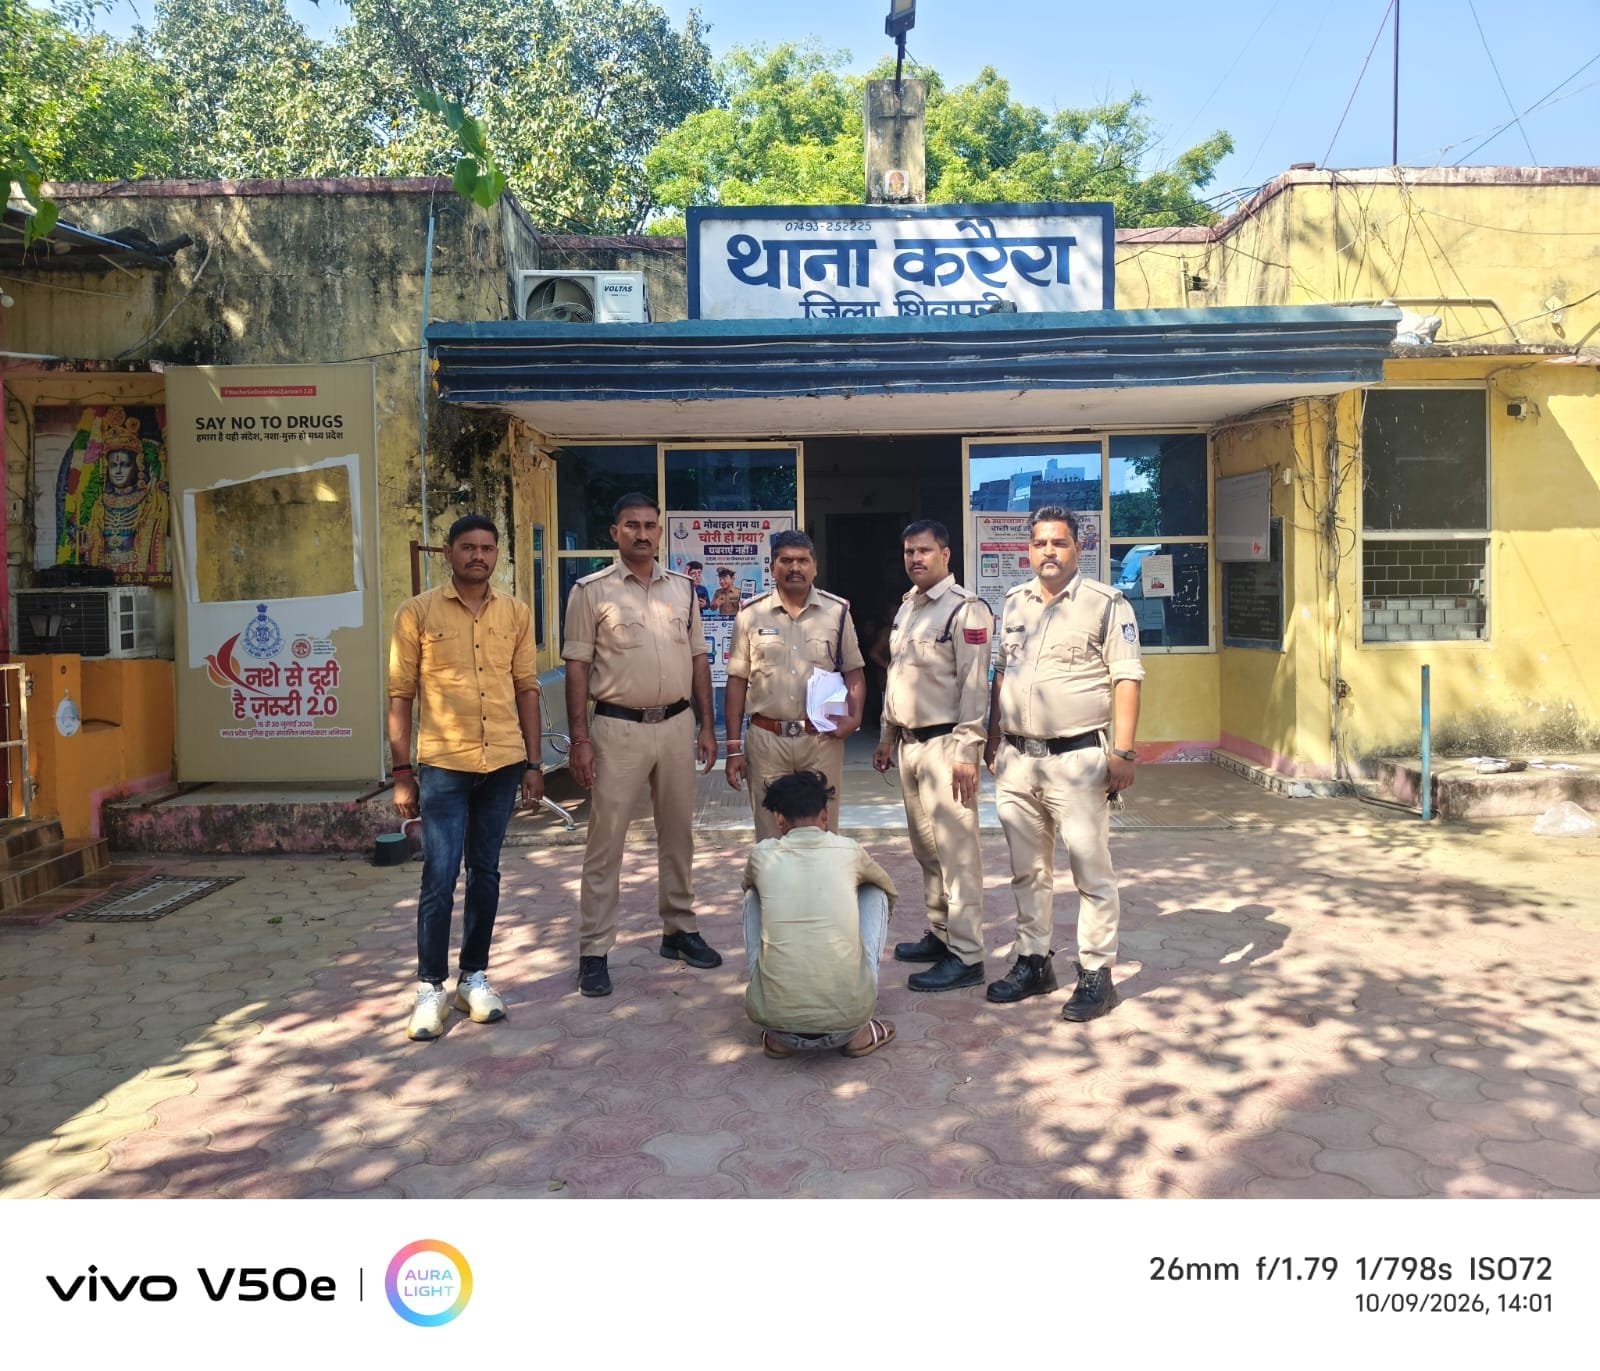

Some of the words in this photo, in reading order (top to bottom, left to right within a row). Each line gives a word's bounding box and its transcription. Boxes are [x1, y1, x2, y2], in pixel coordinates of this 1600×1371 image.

[785, 221, 872, 232] 07493-252225
[726, 233, 877, 289] थाना
[893, 217, 1078, 289] करैरा
[604, 285, 633, 293] VOLTAS
[195, 417, 227, 430] SAY
[231, 416, 256, 430] NO
[260, 415, 282, 429] TO
[287, 415, 344, 429] DRUGS
[196, 433, 217, 443] हमारा
[218, 431, 224, 442] है
[225, 431, 239, 442] यही
[241, 431, 263, 442] संदेश,
[298, 430, 306, 441] हो
[308, 431, 324, 441] मध्य
[326, 429, 344, 441] प्रदेश
[703, 519, 734, 530] मोबाइल
[736, 520, 749, 531] गुम
[750, 520, 760, 529] या
[698, 530, 721, 543] चोरी
[723, 530, 735, 543] हो
[737, 532, 765, 543] गया?
[244, 661, 281, 688] नशे
[284, 661, 304, 688] से
[307, 659, 340, 695] दूरी
[232, 688, 247, 719] है
[307, 696, 338, 716] 2.0
